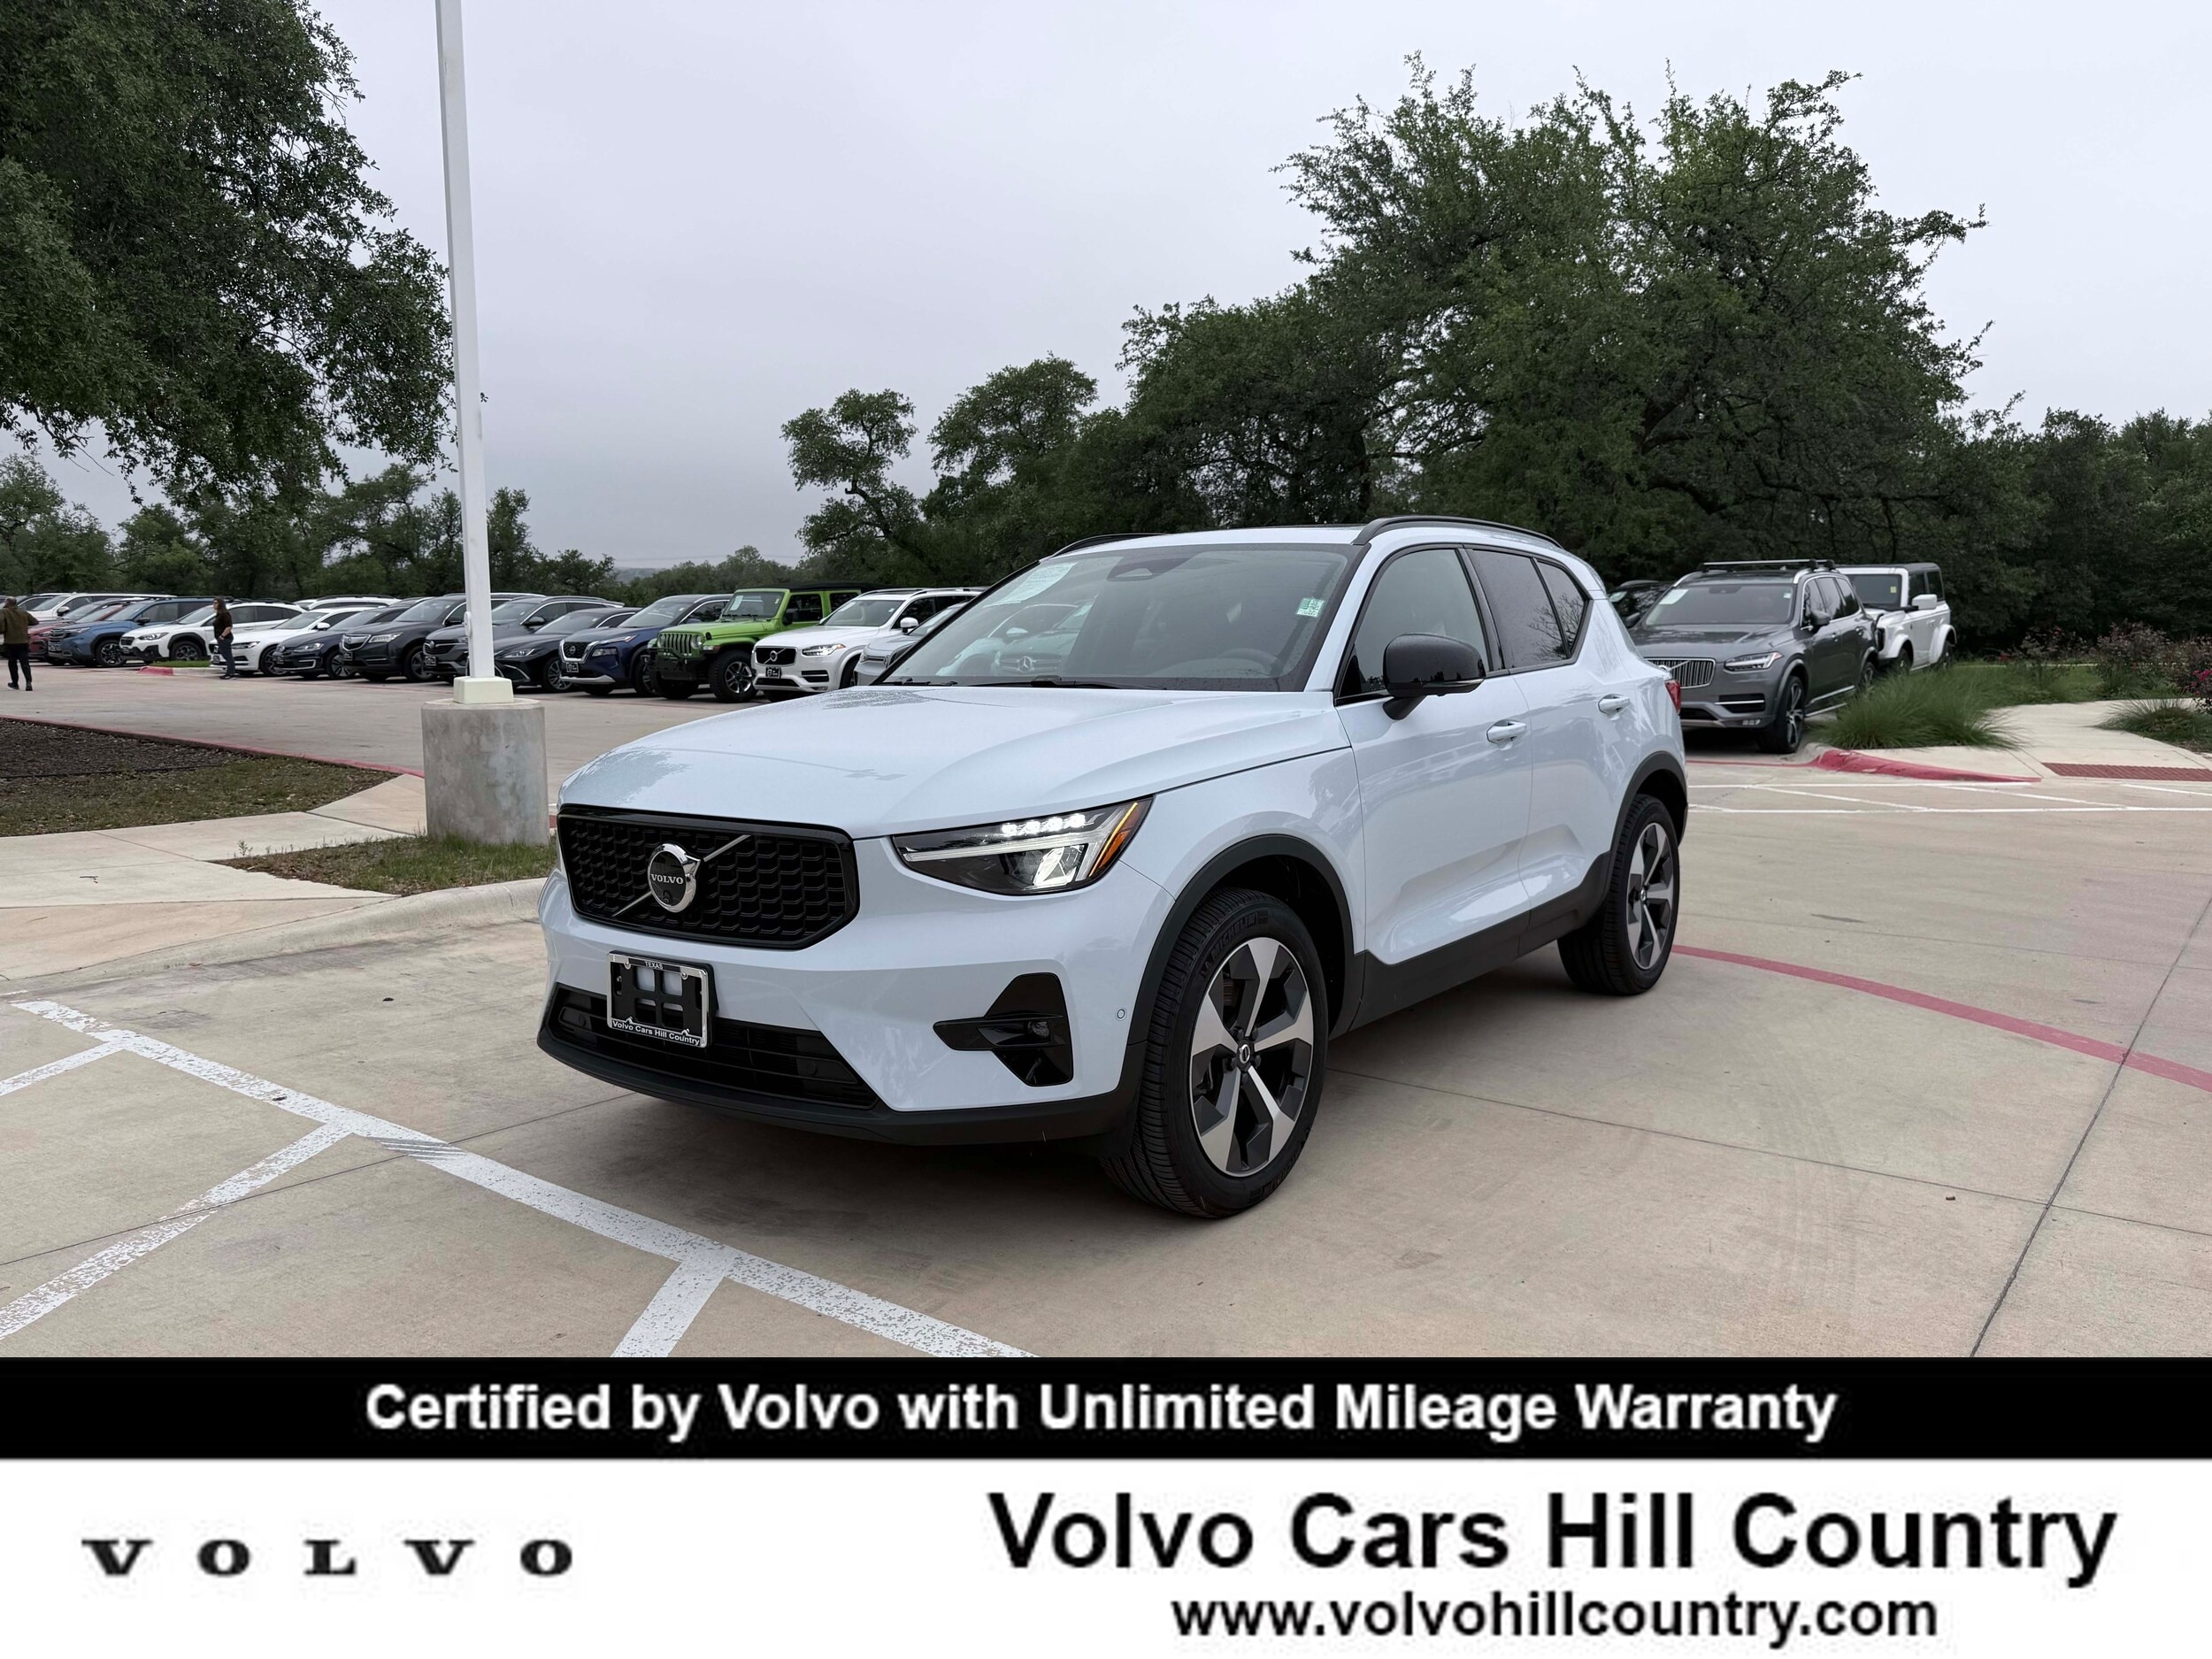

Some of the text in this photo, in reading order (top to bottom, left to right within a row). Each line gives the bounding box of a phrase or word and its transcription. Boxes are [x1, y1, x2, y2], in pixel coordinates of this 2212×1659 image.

[650, 873, 684, 885] VOLVO
[644, 961, 664, 970] TEXAS
[612, 1020, 700, 1046] Volvo Cars Hill Country
